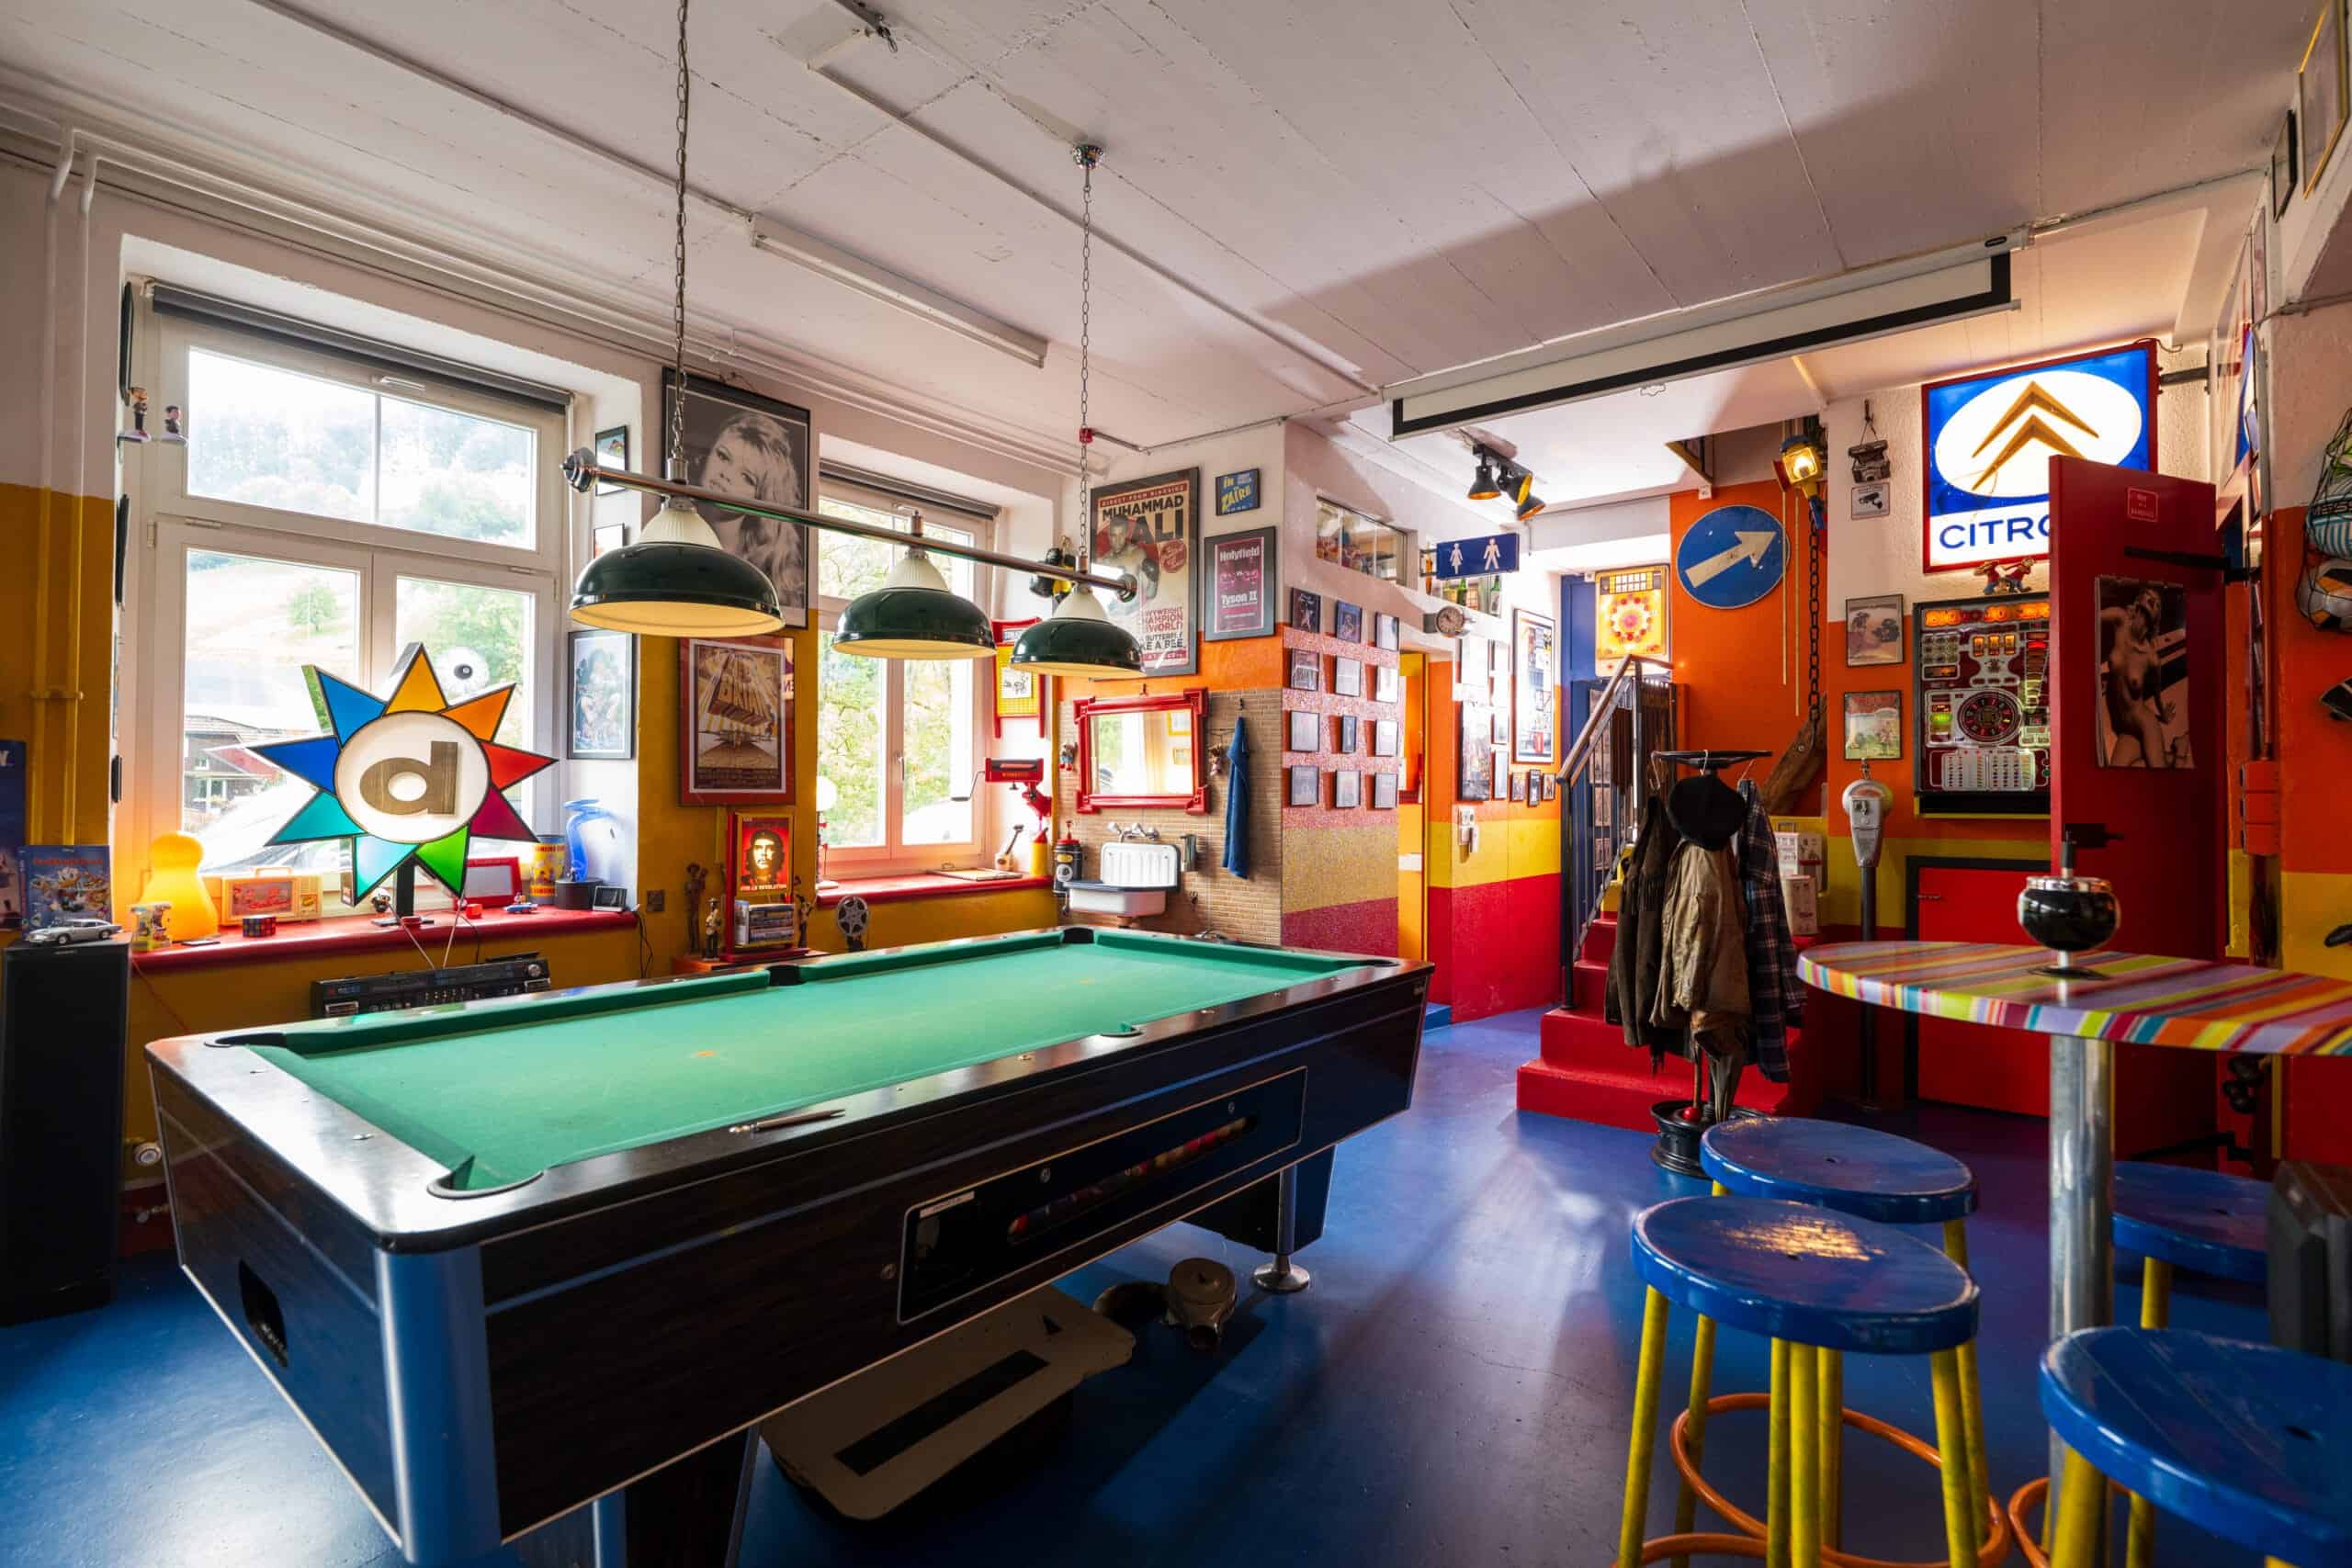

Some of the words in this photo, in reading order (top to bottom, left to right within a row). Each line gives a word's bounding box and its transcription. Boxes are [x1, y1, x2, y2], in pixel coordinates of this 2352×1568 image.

[1102, 494, 1184, 521] MUHAMMAD
[1130, 509, 1183, 546] ALI
[1219, 546, 1261, 562] Holyfield
[1220, 592, 1248, 605] Tyson
[359, 740, 458, 815] d
